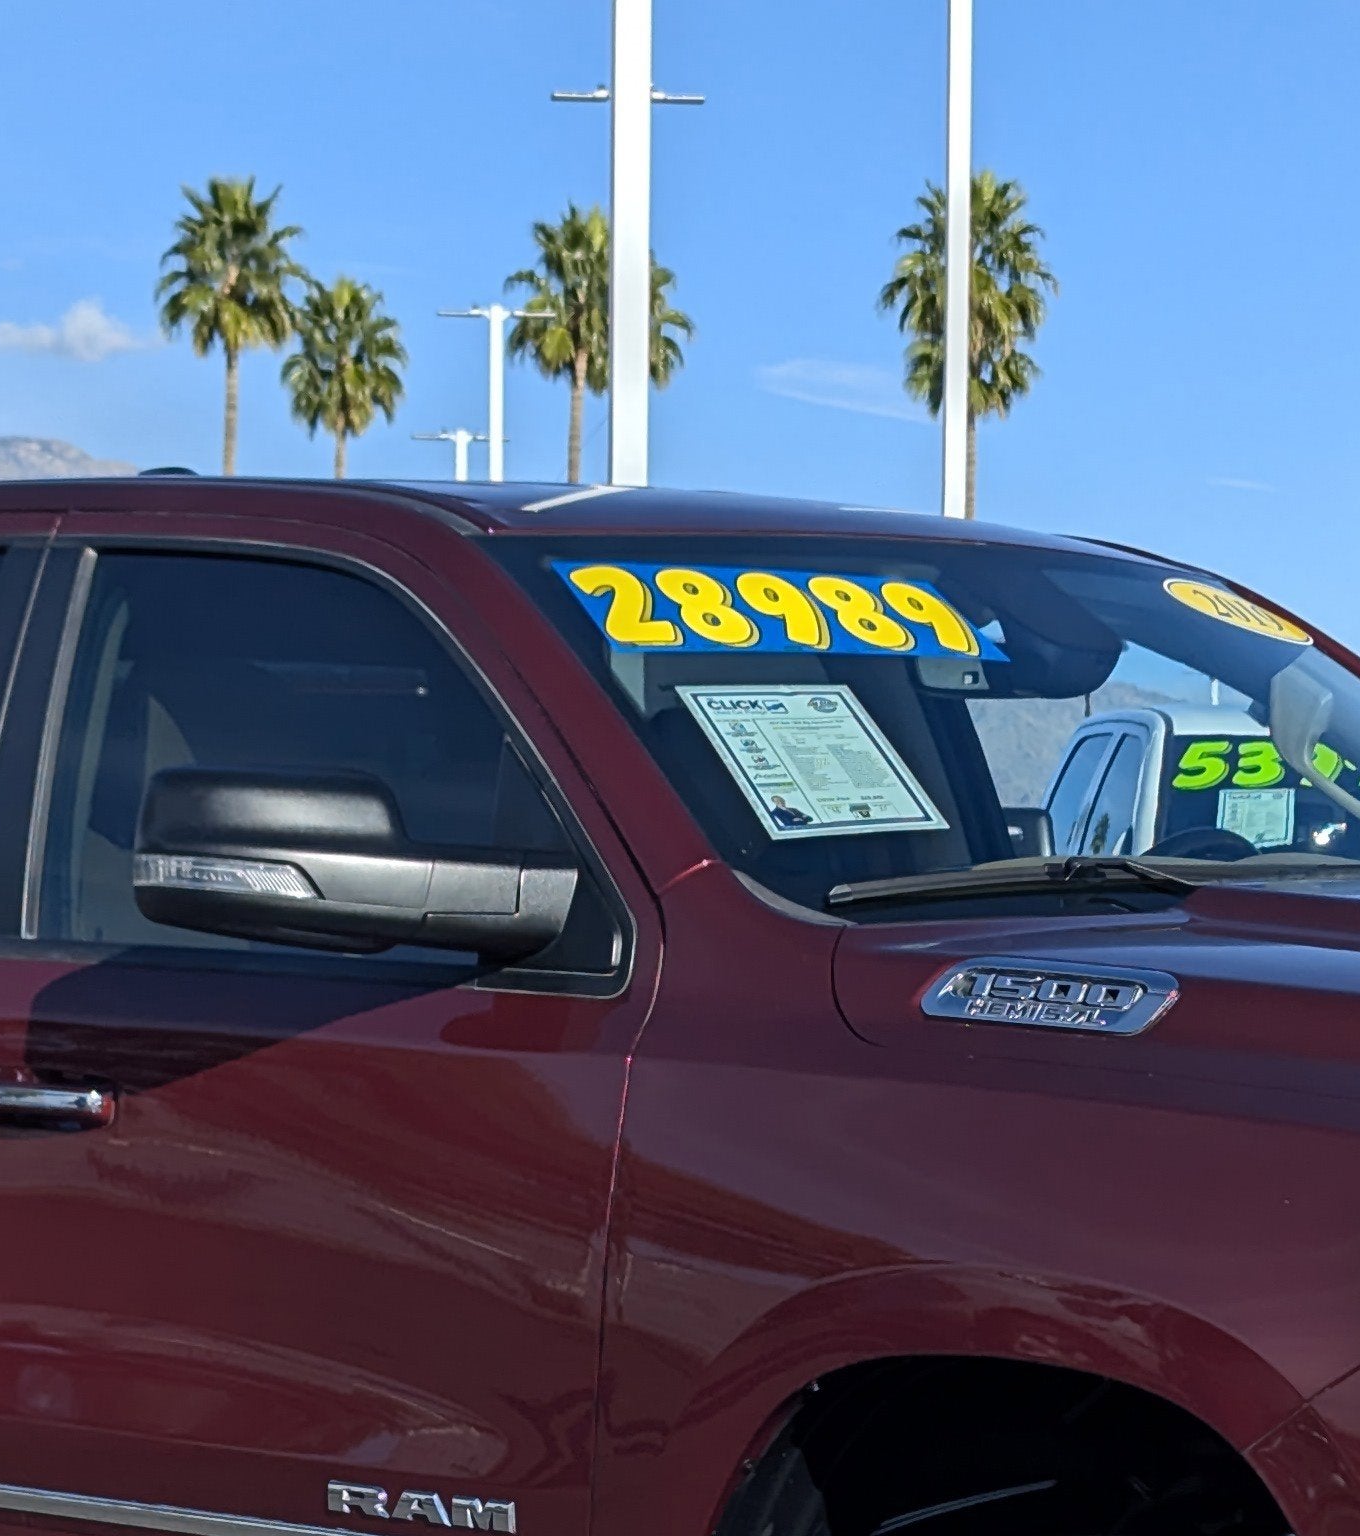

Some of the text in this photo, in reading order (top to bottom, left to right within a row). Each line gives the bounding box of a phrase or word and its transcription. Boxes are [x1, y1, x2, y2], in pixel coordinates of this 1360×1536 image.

[569, 565, 981, 656] 28989
[707, 699, 763, 711] CLICK
[964, 998, 1042, 1023] HEMI
[968, 972, 1145, 1011] 1500
[327, 1479, 517, 1534] RAM
